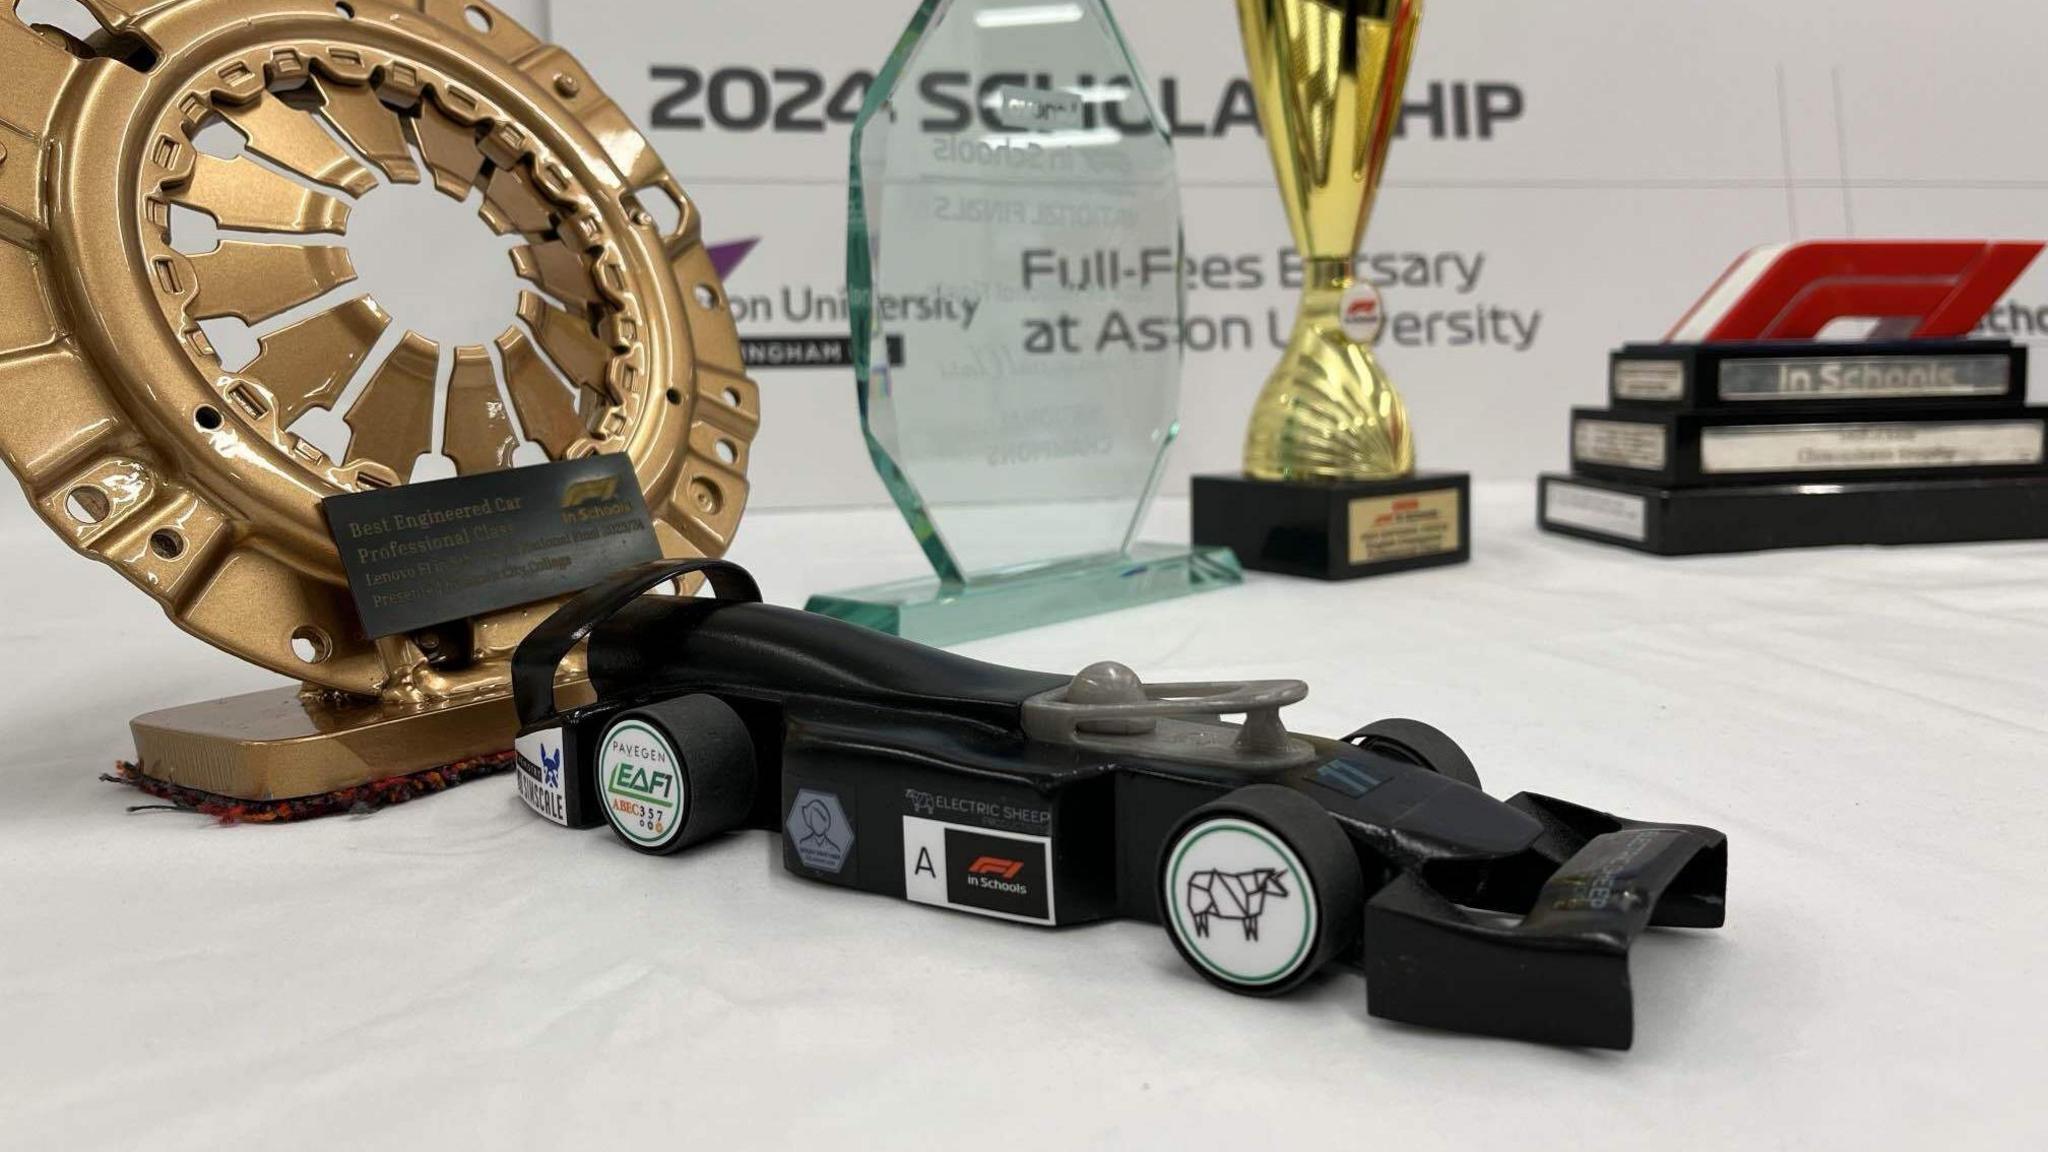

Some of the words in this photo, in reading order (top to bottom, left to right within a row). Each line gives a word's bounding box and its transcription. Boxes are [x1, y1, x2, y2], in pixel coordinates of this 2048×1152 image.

[649, 65, 878, 133] 2024
[1021, 249, 1263, 291] Full-Fees
[783, 286, 981, 330] Uniersity
[1023, 313, 1081, 353] at
[1095, 310, 1253, 353] Ason
[349, 518, 392, 539] Best
[394, 499, 492, 530] Engineered
[495, 496, 522, 512] Car
[358, 527, 470, 565] Professional
[365, 565, 416, 588] Lenovo
[612, 741, 666, 762] PAVEGEN
[935, 796, 1000, 818] ELECTRIC
[1002, 804, 1051, 824] SHEEP
[914, 846, 936, 879] A
[967, 873, 979, 885] in
[981, 876, 1028, 895] Schools
